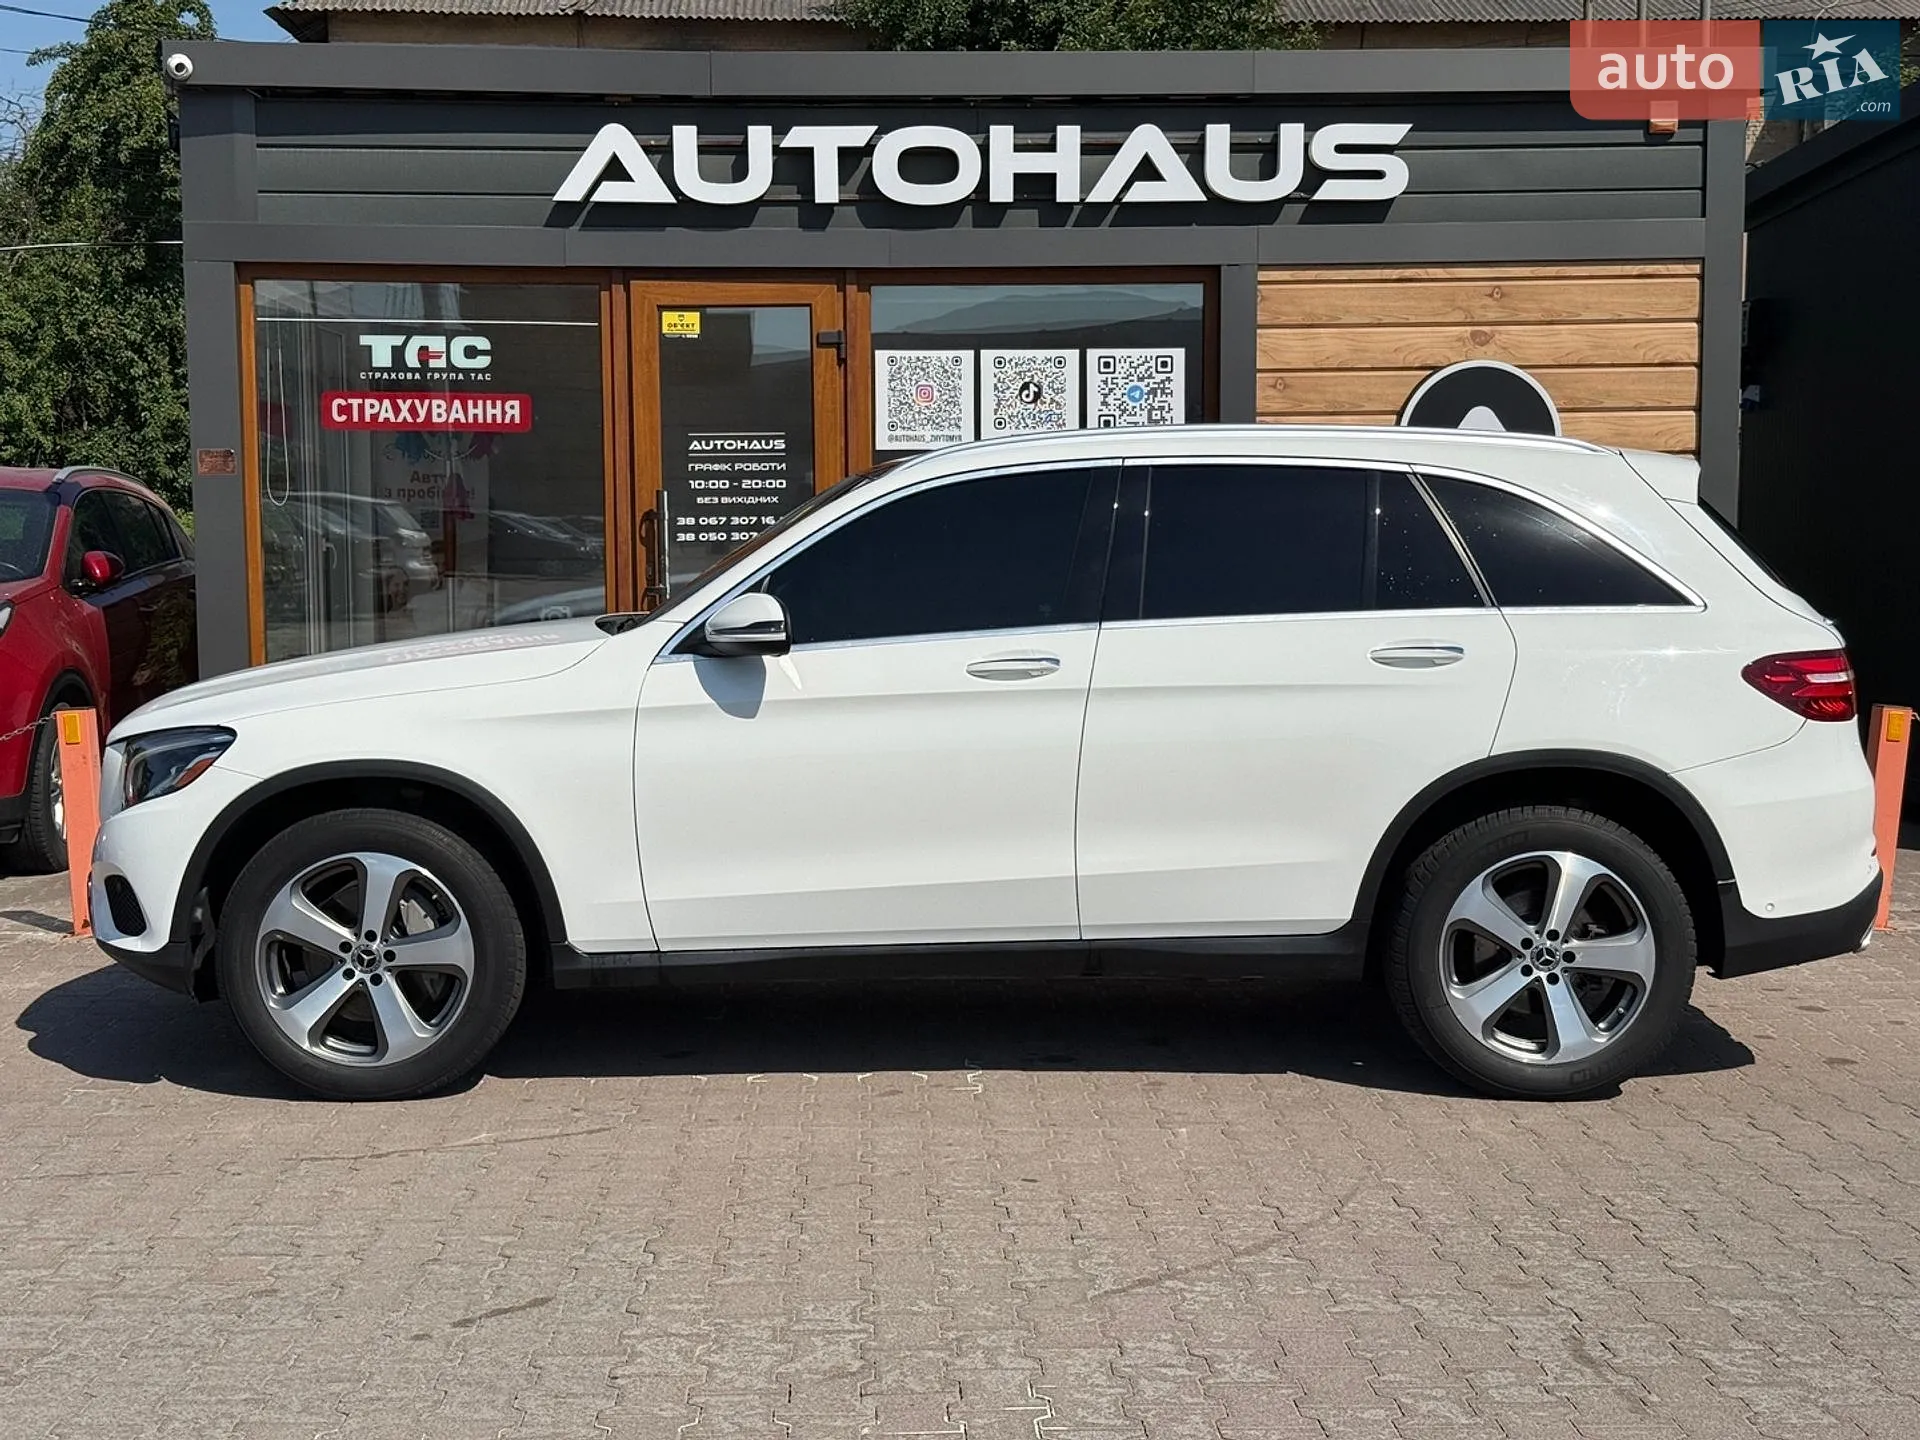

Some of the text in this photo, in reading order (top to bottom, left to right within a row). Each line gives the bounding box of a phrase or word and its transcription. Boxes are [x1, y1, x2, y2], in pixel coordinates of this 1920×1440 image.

[551, 122, 1413, 206] AUTOHAUS
[359, 371, 492, 381] СТРАХОВА ГРУПА ТАС
[331, 398, 521, 424] СТРАХУВАННЯ
[688, 439, 786, 451] AUTOHAUS
[688, 462, 787, 472] ГРАФІК РОБОТИ
[688, 479, 729, 489] 10:00
[741, 479, 787, 488] 20:00
[696, 495, 779, 504] БЕЗ ВИХІДНИХ
[676, 517, 696, 525] 38
[699, 517, 727, 525] 067
[730, 516, 758, 525] 307
[676, 532, 758, 541] 38 050 307
